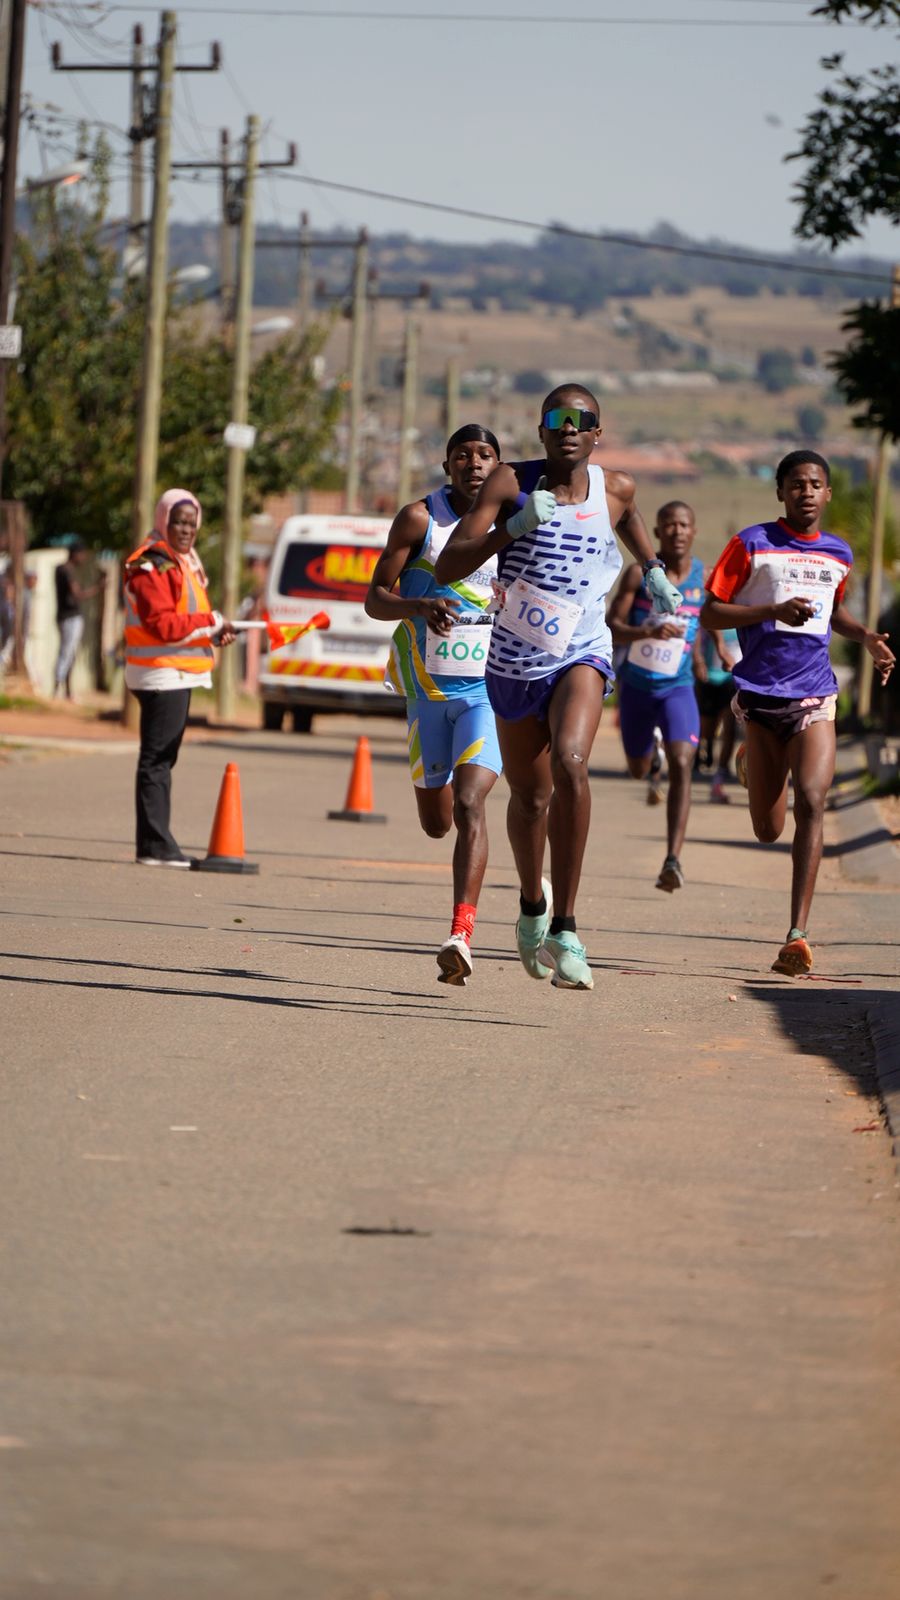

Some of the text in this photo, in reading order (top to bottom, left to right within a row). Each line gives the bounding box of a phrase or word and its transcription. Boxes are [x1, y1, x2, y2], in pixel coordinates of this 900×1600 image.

[518, 600, 560, 636] 106
[435, 641, 485, 661] 406
[641, 643, 672, 663] 018
